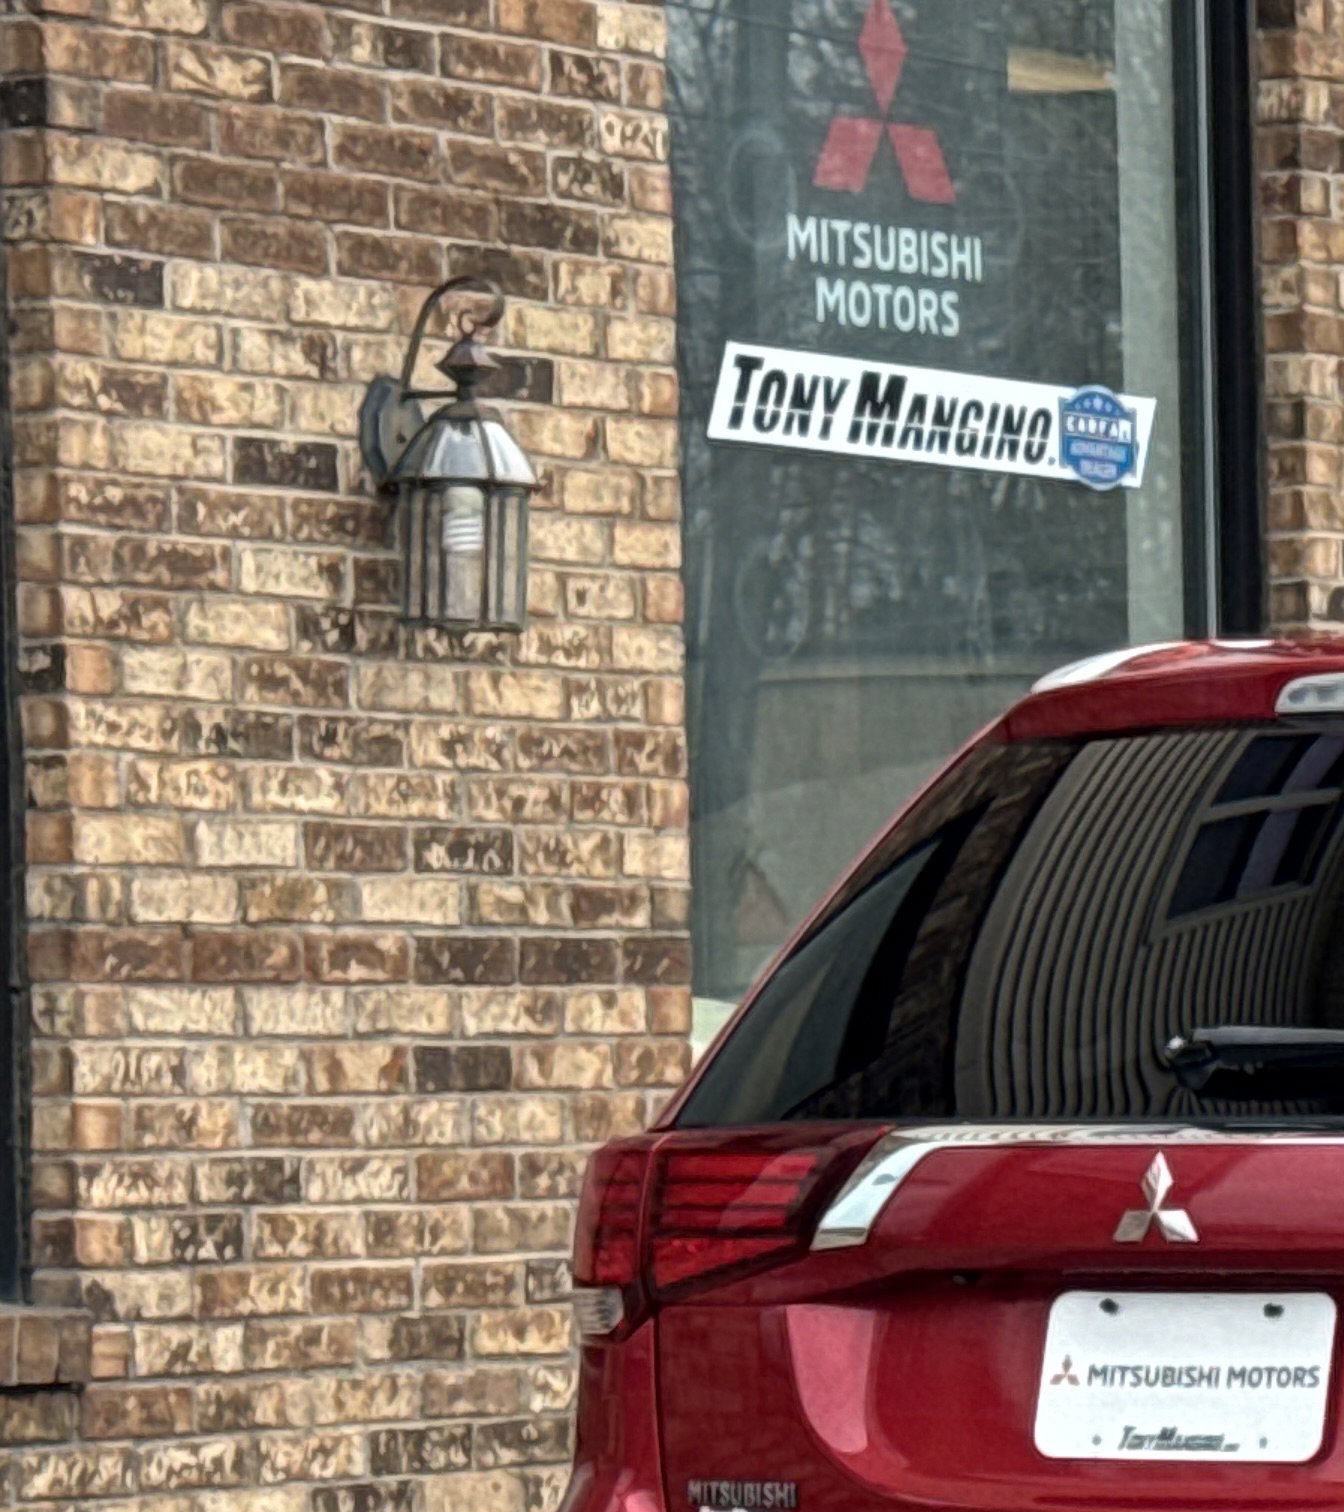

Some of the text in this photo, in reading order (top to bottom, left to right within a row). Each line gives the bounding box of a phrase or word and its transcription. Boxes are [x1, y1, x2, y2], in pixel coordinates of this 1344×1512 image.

[786, 213, 982, 282] MITSUBISHI
[815, 277, 960, 337] MOTORS
[727, 354, 849, 440] TONY
[1087, 1363, 1320, 1390] MITSUBISHI MOTORS
[688, 1479, 797, 1508] MITSUBISHI
